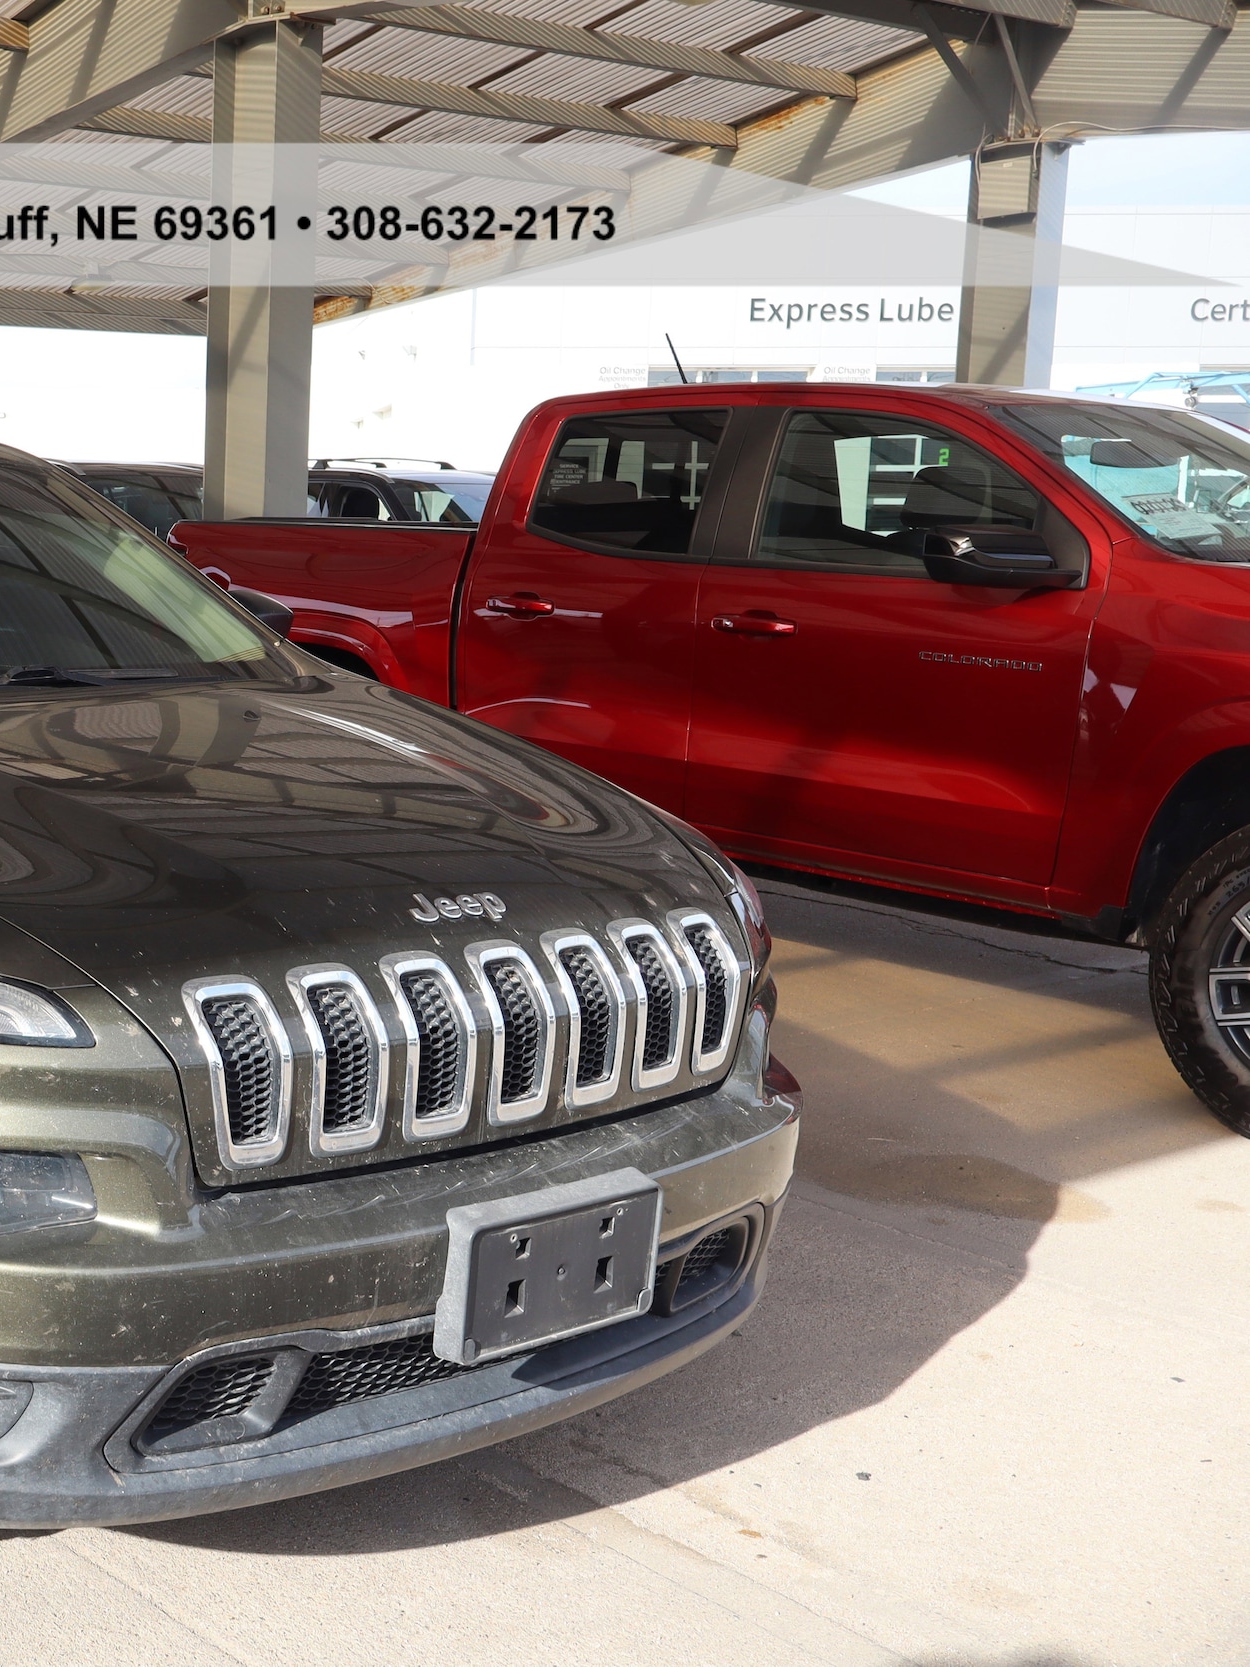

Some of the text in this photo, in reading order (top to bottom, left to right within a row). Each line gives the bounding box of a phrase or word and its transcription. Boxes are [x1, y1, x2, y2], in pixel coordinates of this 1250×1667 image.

[750, 296, 954, 329] Express Lube
[1190, 297, 1250, 322] Cert
[599, 366, 646, 377] Oil Change
[823, 366, 870, 376] Oil Change
[918, 651, 1043, 672] COLORADO
[409, 891, 507, 922] Jeep
